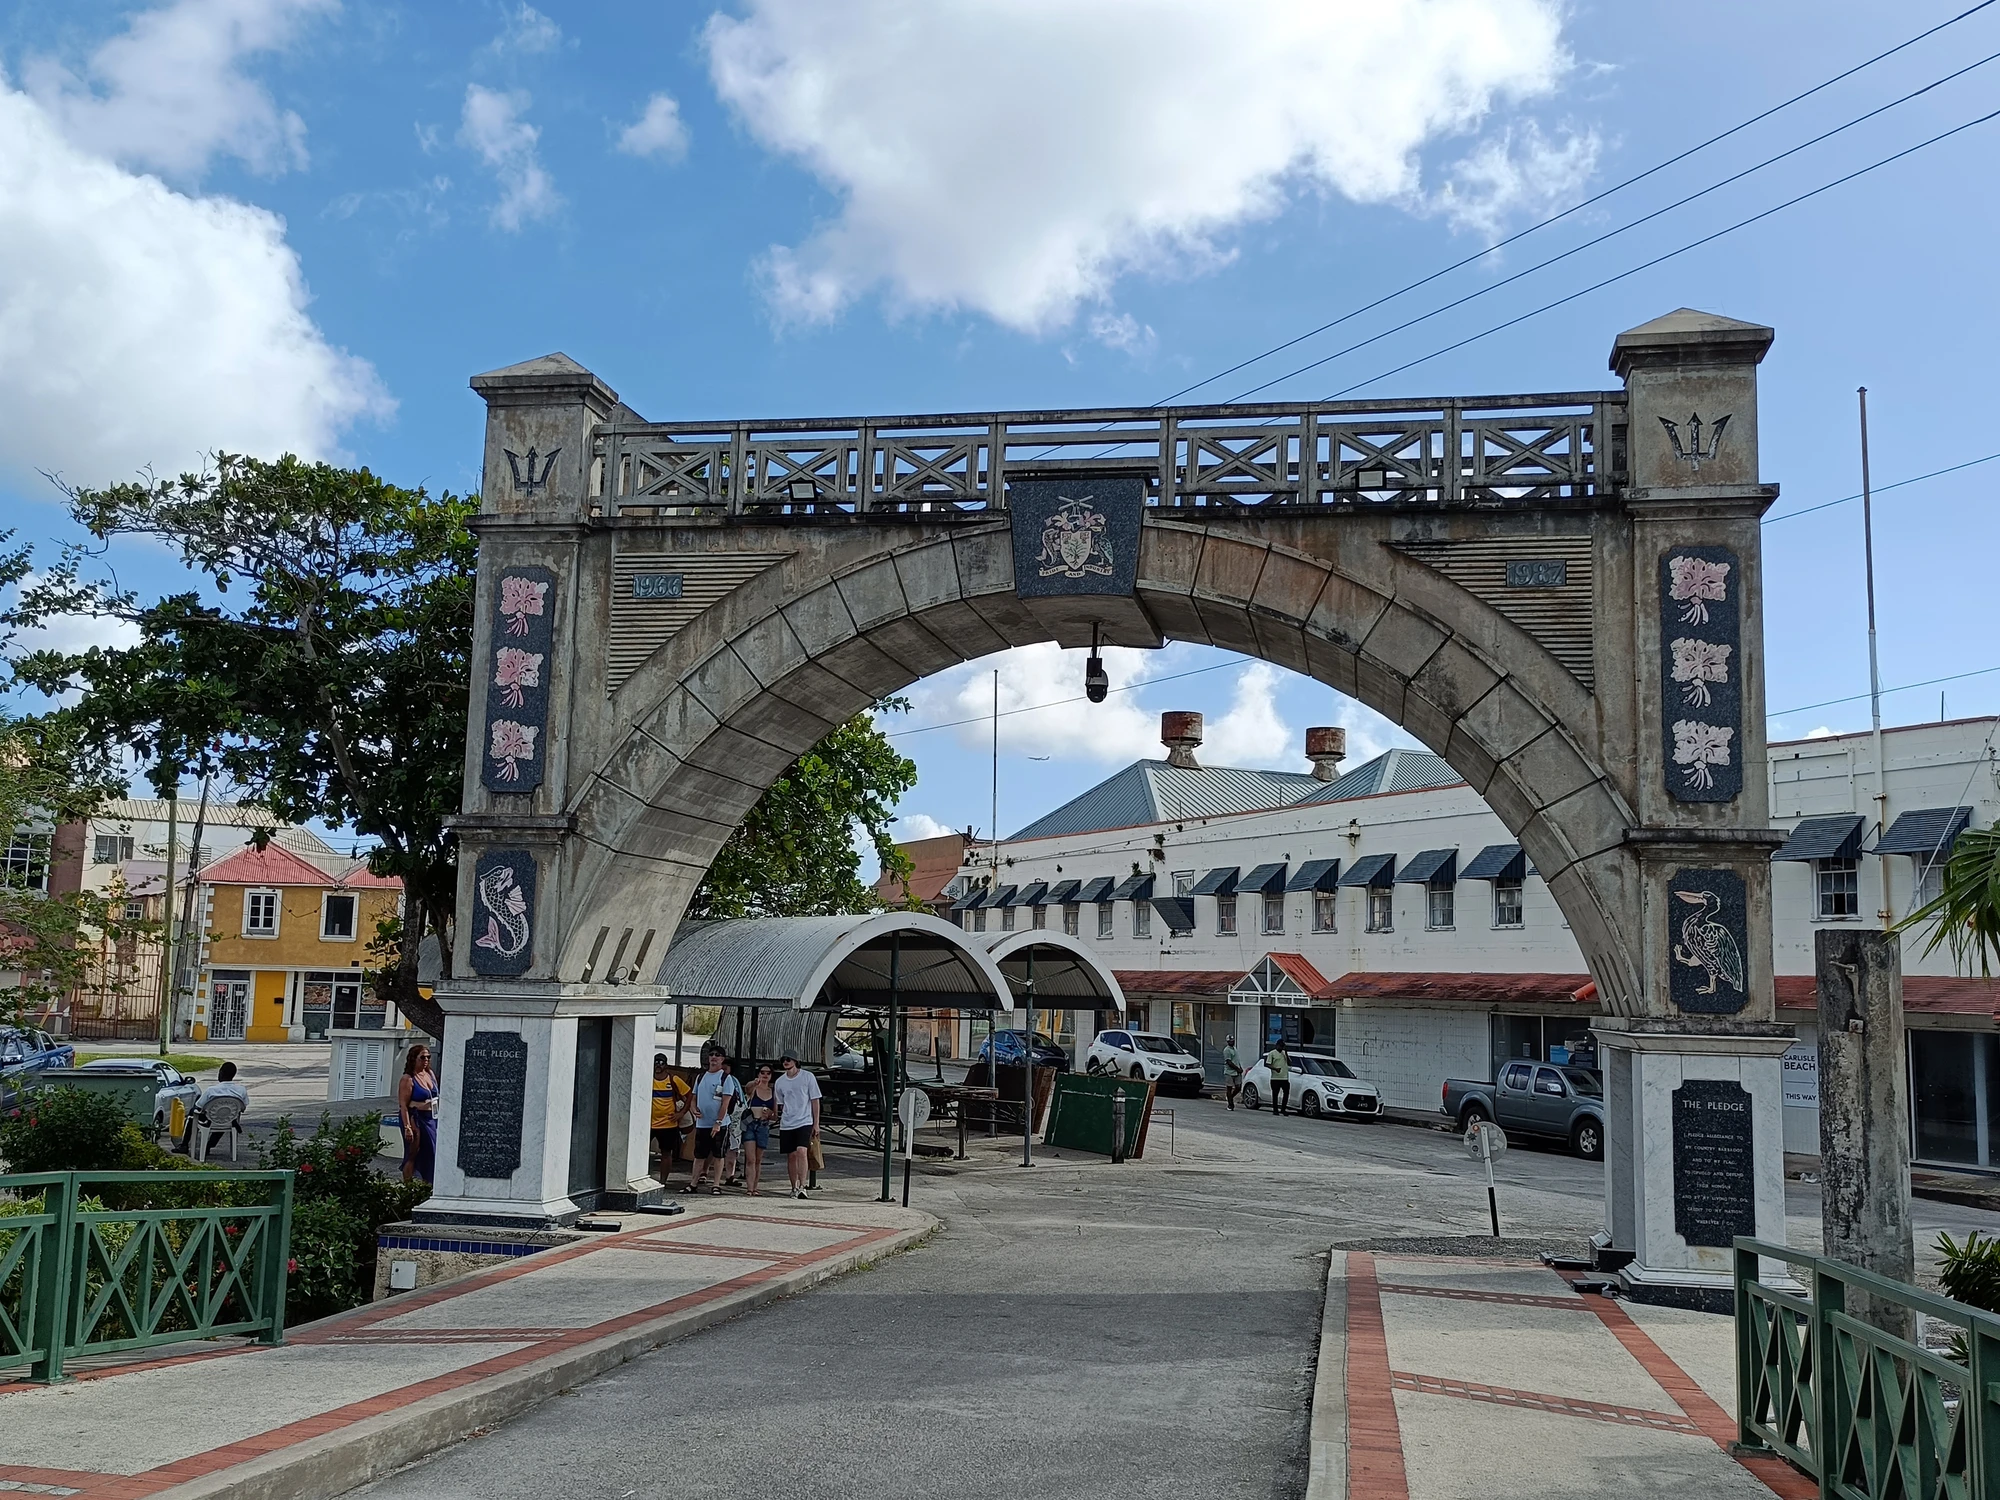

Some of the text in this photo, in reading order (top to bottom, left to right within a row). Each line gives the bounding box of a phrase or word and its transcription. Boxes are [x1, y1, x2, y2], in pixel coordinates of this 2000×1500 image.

[1507, 562, 1564, 585] 1987
[634, 576, 681, 597] 1966
[472, 1049, 519, 1059] THE PLEDGE
[1783, 1054, 1815, 1062] CARLISLE
[1784, 1062, 1816, 1071] BEACH
[1785, 1093, 1801, 1101] THIS
[1682, 1099, 1745, 1112] THE PLEDGE
